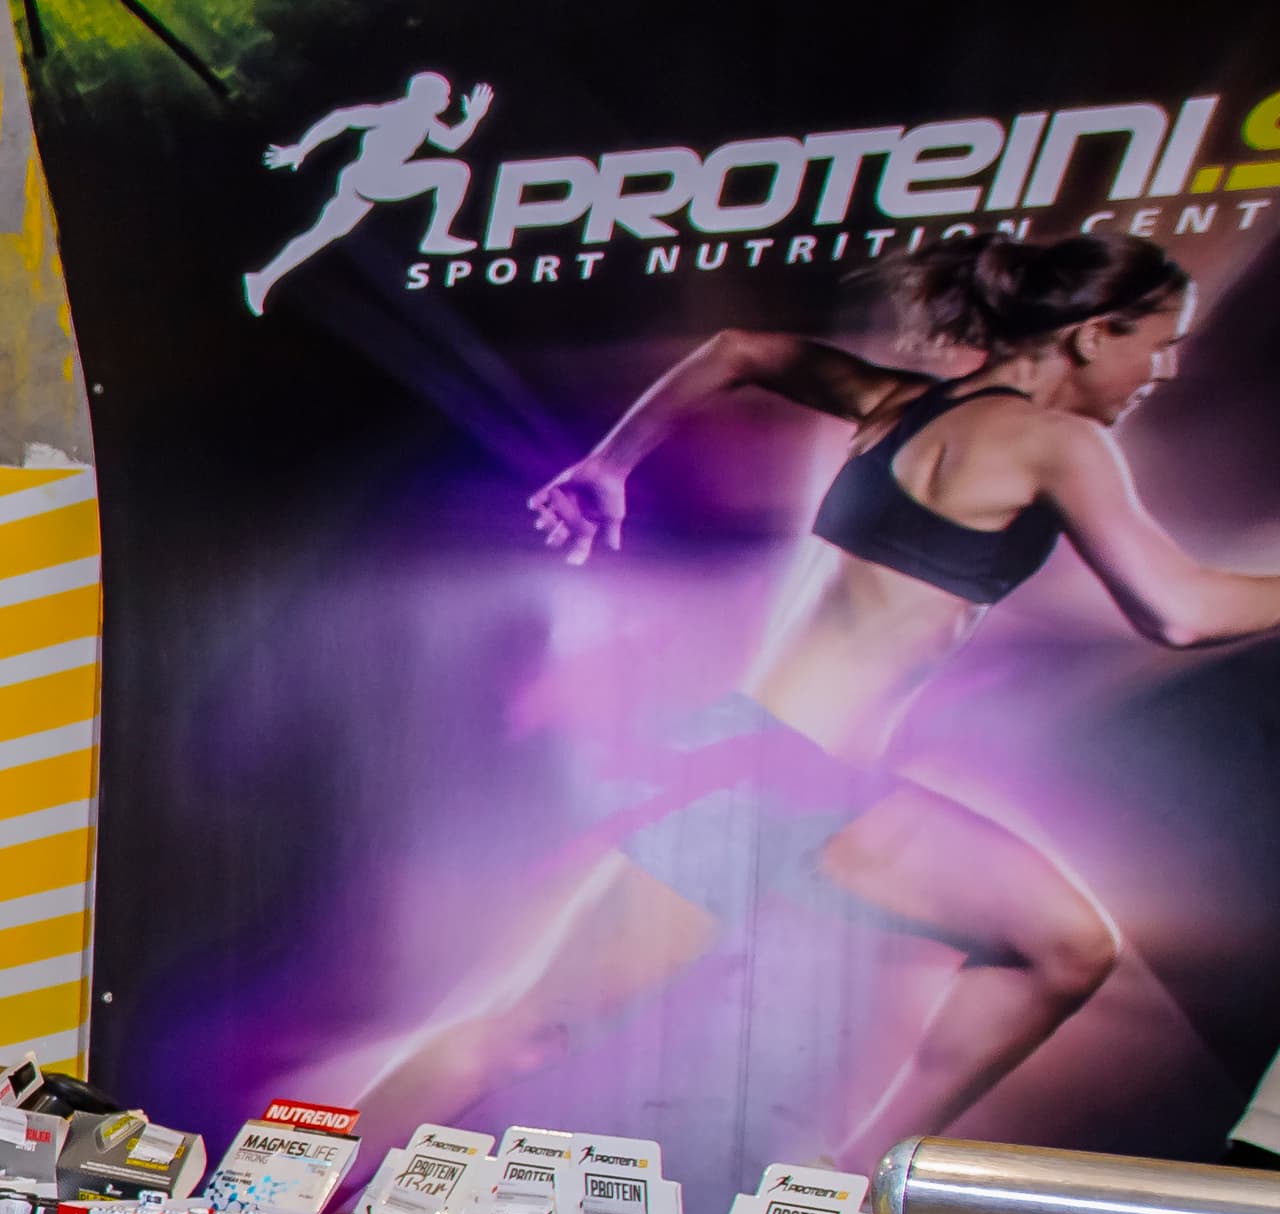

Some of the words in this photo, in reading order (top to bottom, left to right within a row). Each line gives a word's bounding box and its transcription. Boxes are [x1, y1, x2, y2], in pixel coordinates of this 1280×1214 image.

[406, 250, 601, 290] SPORT
[266, 1104, 351, 1129] NUTREND
[235, 1150, 269, 1165] STRONG
[243, 1134, 339, 1161] MAGNESLIFE
[413, 1159, 457, 1182] PROTEIN
[590, 1178, 642, 1203] PROTEIN
